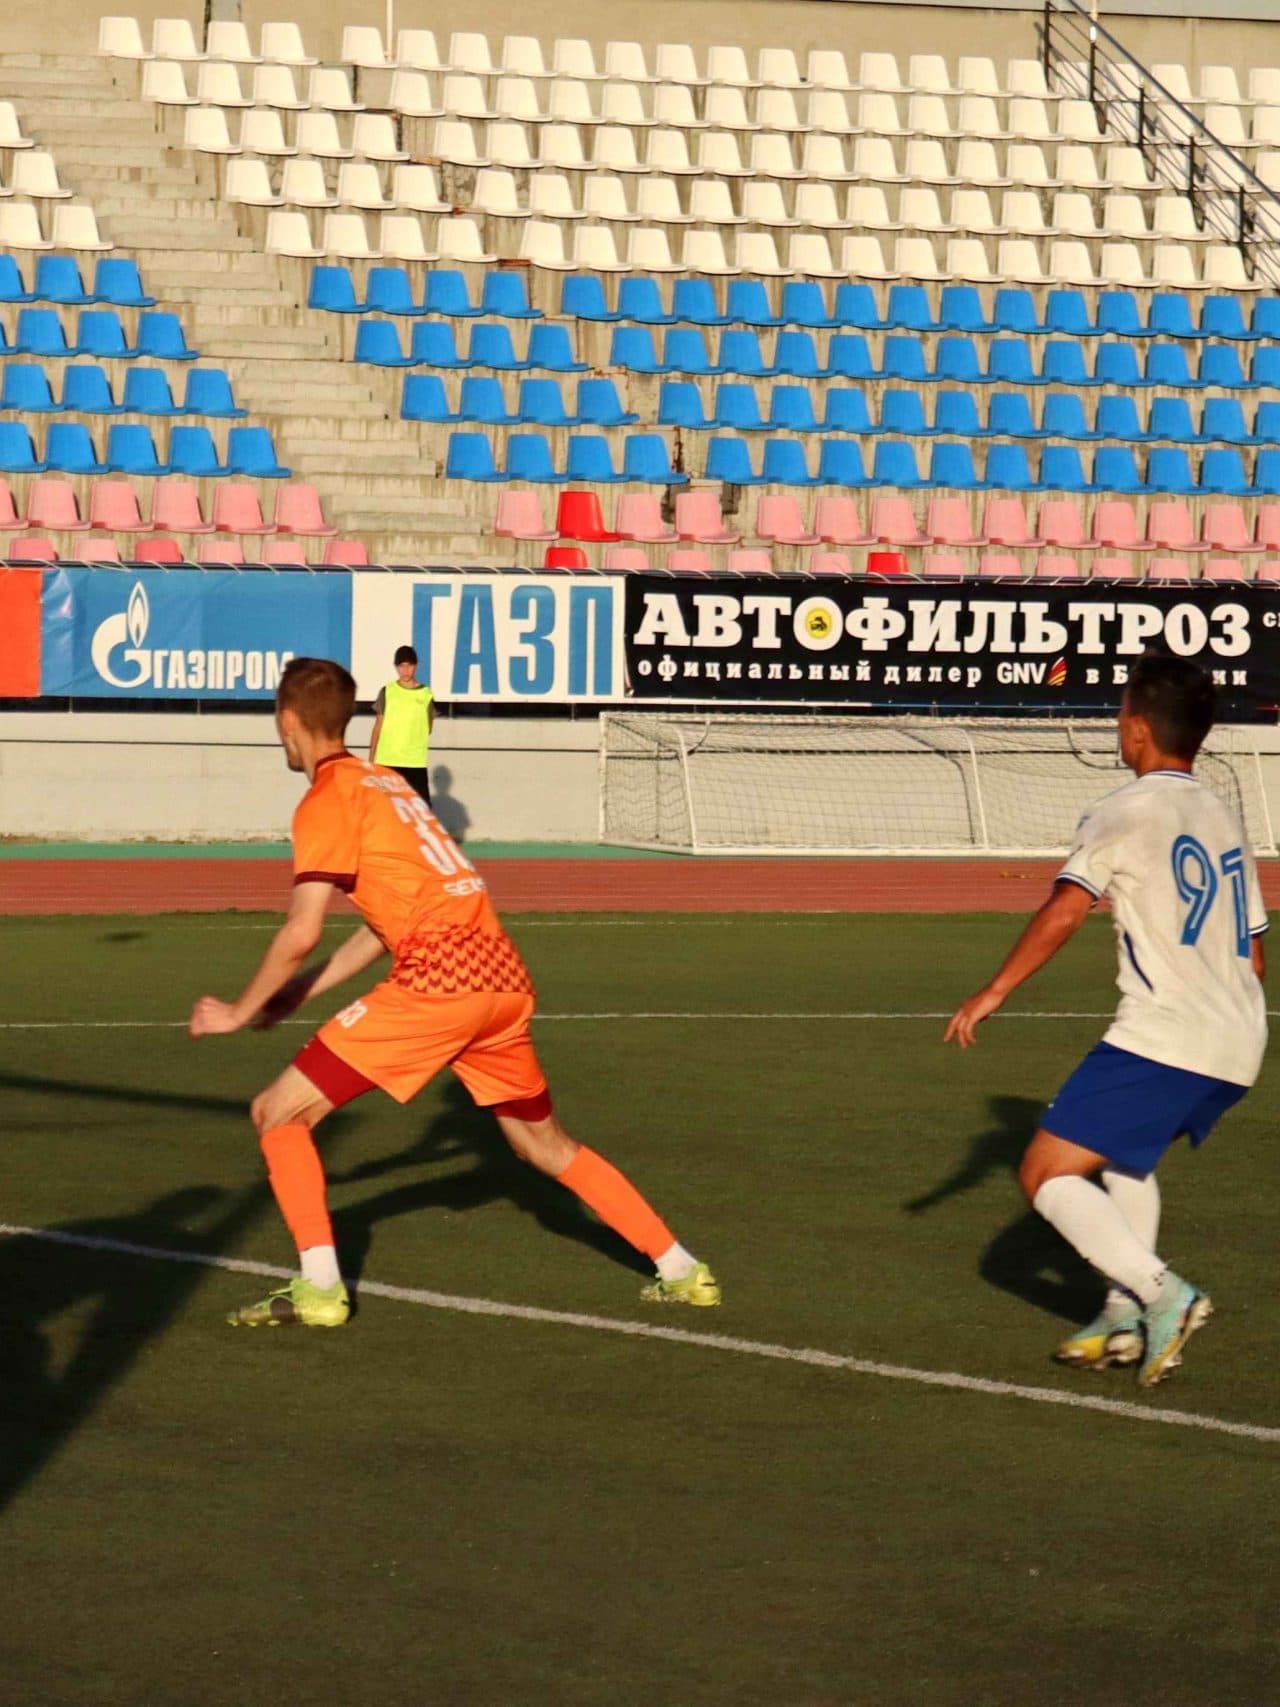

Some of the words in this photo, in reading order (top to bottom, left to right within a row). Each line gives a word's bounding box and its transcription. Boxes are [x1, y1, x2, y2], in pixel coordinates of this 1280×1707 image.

[410, 583, 613, 696] ГАЗП
[637, 654, 872, 682] официальный
[883, 665, 982, 688] дилер
[996, 662, 1047, 684] GNV
[1085, 668, 1100, 685] в
[1172, 834, 1252, 959] 91
